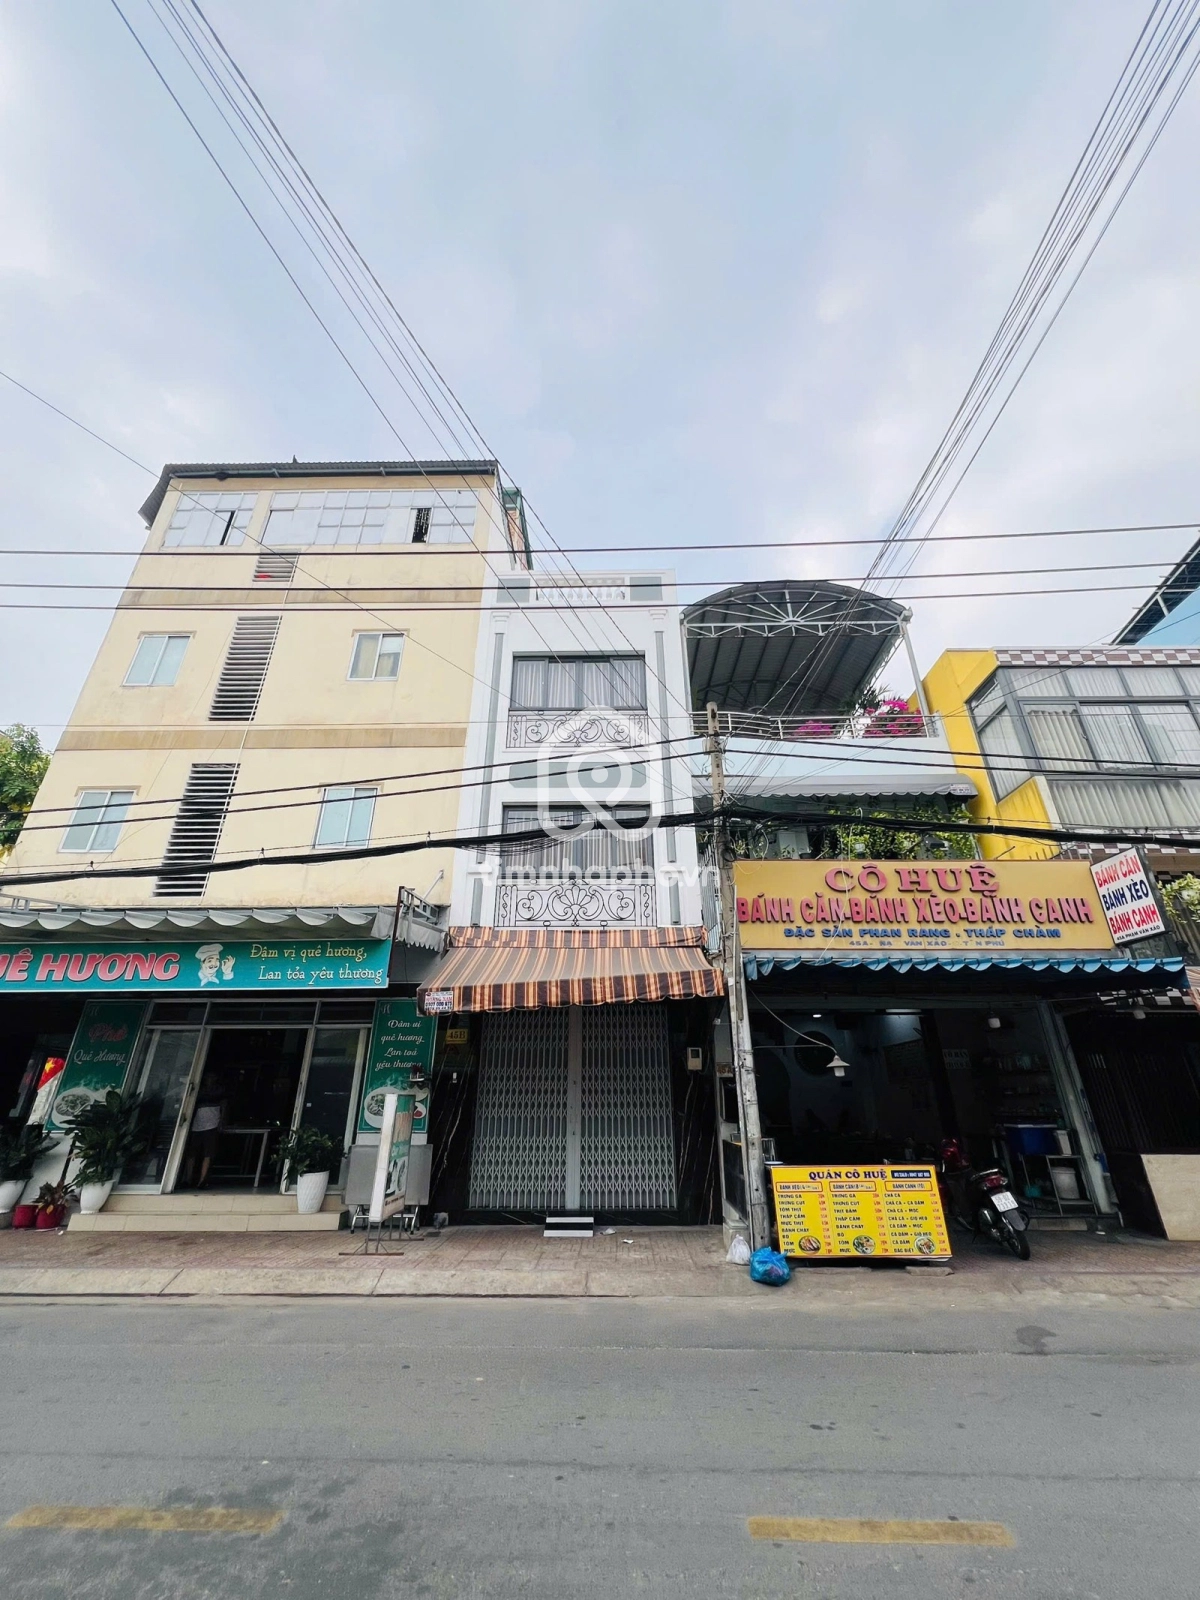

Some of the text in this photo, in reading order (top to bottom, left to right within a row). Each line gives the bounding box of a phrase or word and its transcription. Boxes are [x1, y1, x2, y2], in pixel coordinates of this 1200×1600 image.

[825, 862, 1000, 898] CÔ HUỆ
[1095, 855, 1141, 888] BÁNH CĂN
[1102, 878, 1149, 911] BÁNH XÈO
[736, 892, 794, 923] BÁNH
[1029, 898, 1094, 924] CANH
[1109, 903, 1160, 934] BÁNH CANH
[784, 926, 816, 940] ĐẶC
[822, 925, 853, 938] SẢN
[859, 928, 902, 938] PHAN
[908, 928, 950, 938] RANG
[964, 926, 1006, 938] THÁP
[1013, 925, 1061, 938] CHÀM
[250, 944, 278, 960] Đậm
[284, 945, 296, 960] vị
[300, 945, 322, 962] quê
[35, 953, 180, 982] HƯƠNG
[258, 964, 383, 984] Lan tỏa yêu thương
[381, 1034, 396, 1044] quê
[448, 1031, 465, 1039] 45B
[74, 1049, 93, 1064] Quê
[384, 1048, 402, 1057] Lan
[375, 1060, 391, 1071] yêu
[809, 1169, 842, 1180] QUÁN
[845, 1168, 860, 1178] CÔ
[864, 1168, 887, 1180] HUỆ
